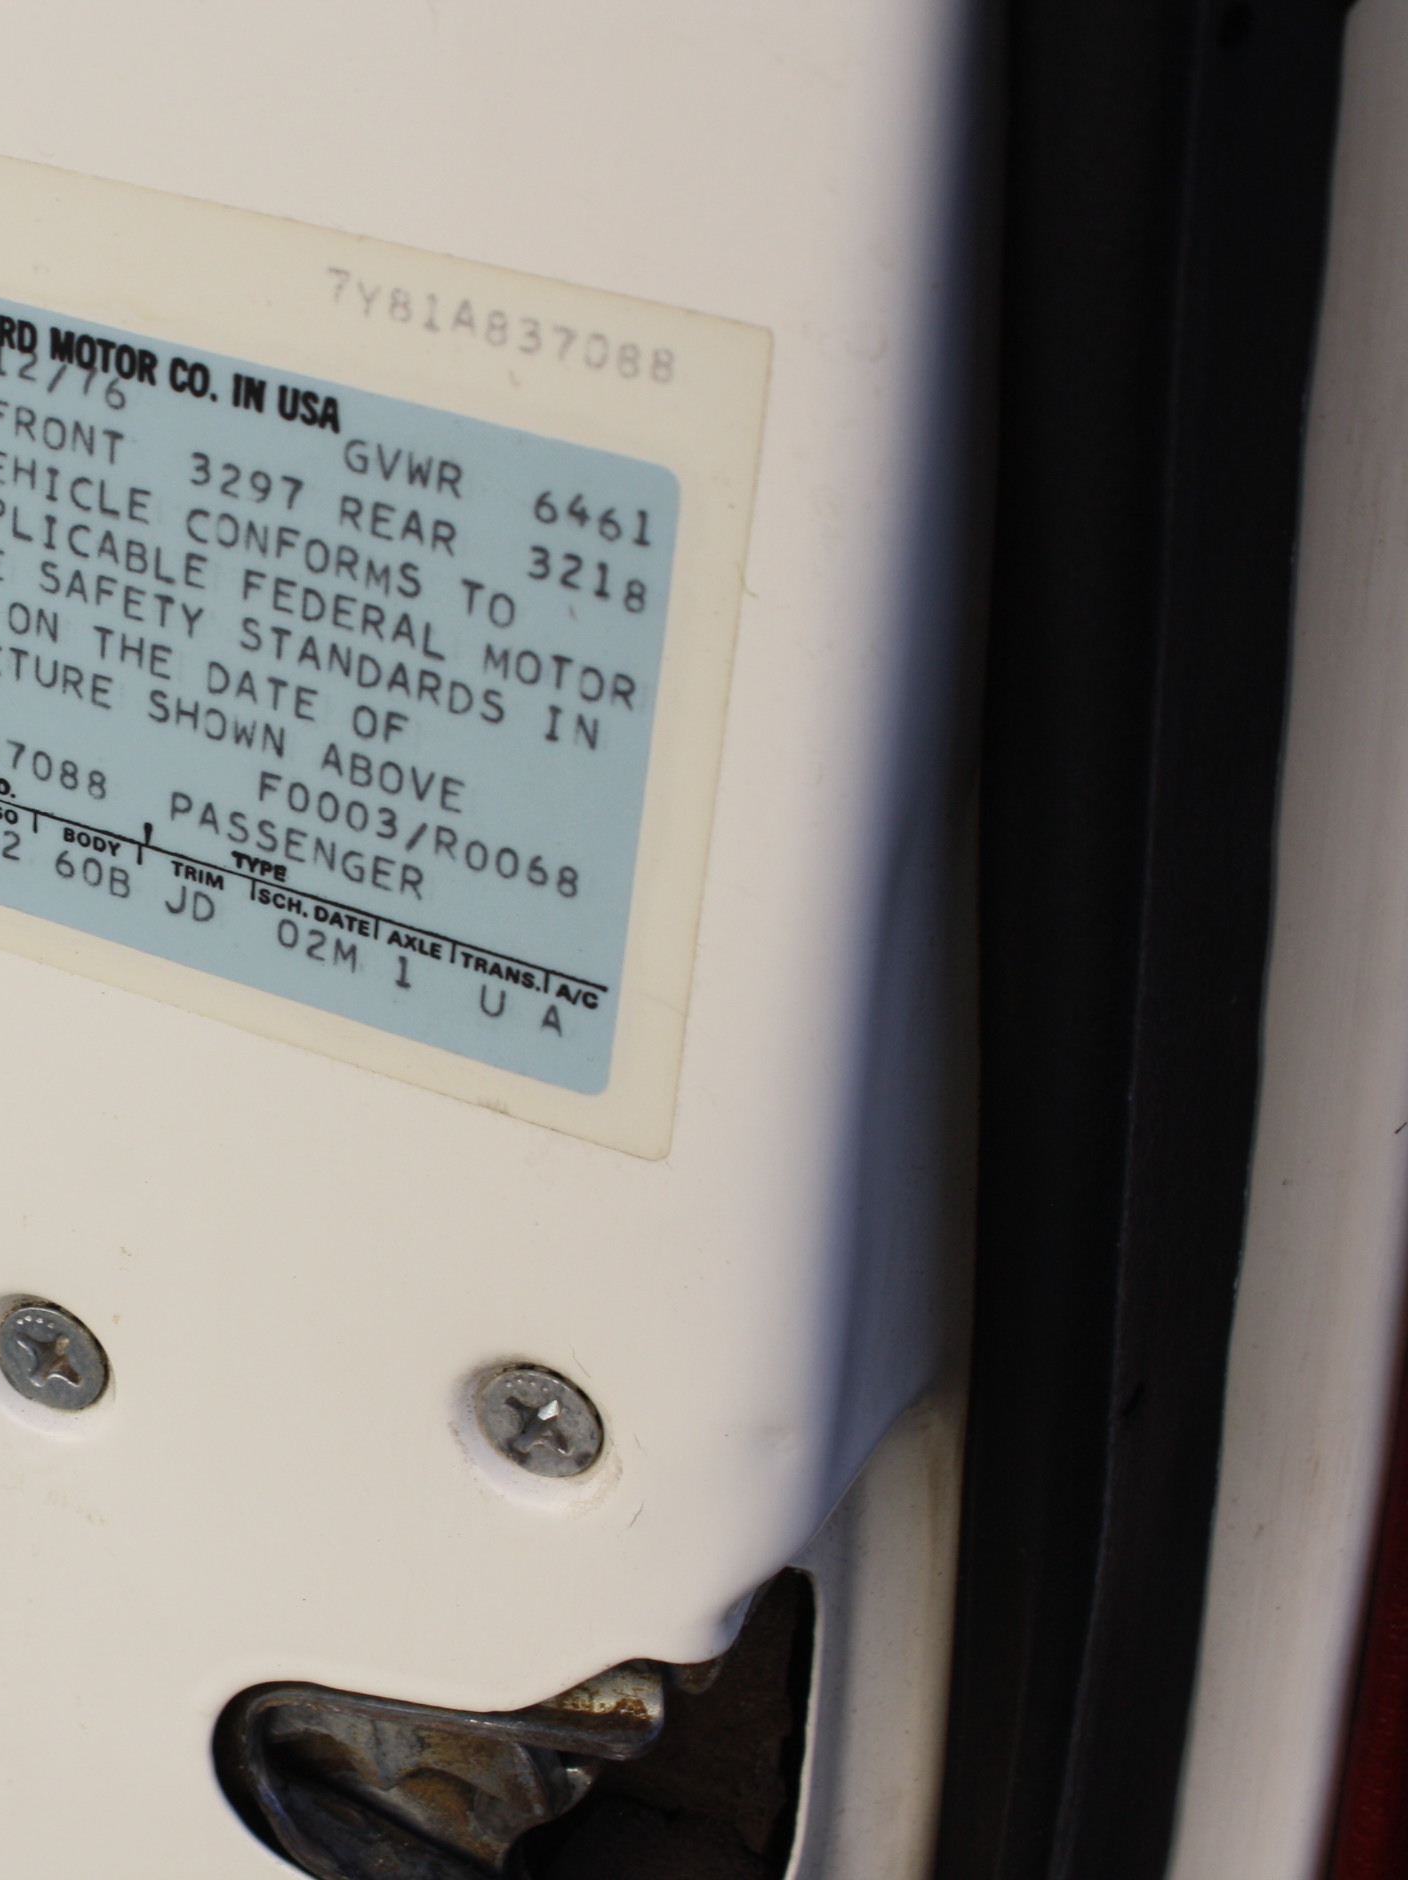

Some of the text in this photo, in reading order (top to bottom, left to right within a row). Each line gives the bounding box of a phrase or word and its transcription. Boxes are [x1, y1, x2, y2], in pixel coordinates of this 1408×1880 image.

[49, 326, 159, 387] MOTOR
[169, 357, 218, 402] CO.
[233, 372, 267, 413] IN
[277, 384, 341, 434] USA
[190, 453, 304, 509] 3297
[339, 495, 457, 556] REAR
[528, 546, 647, 613] 3218
[343, 439, 651, 547] GVWR 6461
[186, 508, 422, 599] CONFORMS
[461, 579, 515, 628] TO
[8, 602, 59, 643] ON
[93, 625, 172, 681] THE
[207, 661, 318, 722] DATE
[352, 705, 409, 742] OF
[39, 560, 204, 638] SAFETY
[240, 617, 505, 724] STANDARDS
[544, 706, 599, 751] IN
[242, 569, 446, 661] FEDERAL
[484, 643, 636, 710] MOTOR
[148, 690, 285, 757] SHOWN
[321, 743, 466, 814] ABOVE
[170, 792, 424, 901] PASSENGER
[231, 850, 287, 882] TYPE
[258, 771, 578, 898] F0003/R0068
[56, 850, 130, 899] 60B
[165, 886, 215, 923] JD
[278, 919, 357, 973] 02M
[395, 956, 412, 989] 1
[480, 984, 506, 1018] U
[541, 1004, 563, 1038] A
[62, 827, 121, 857] BODY
[171, 860, 225, 890] TRIM
[258, 888, 308, 919] SCH.
[314, 905, 370, 938] DATE
[387, 930, 443, 960] AXLE
[460, 951, 541, 993] TRANS.
[555, 984, 599, 1011] A/C
